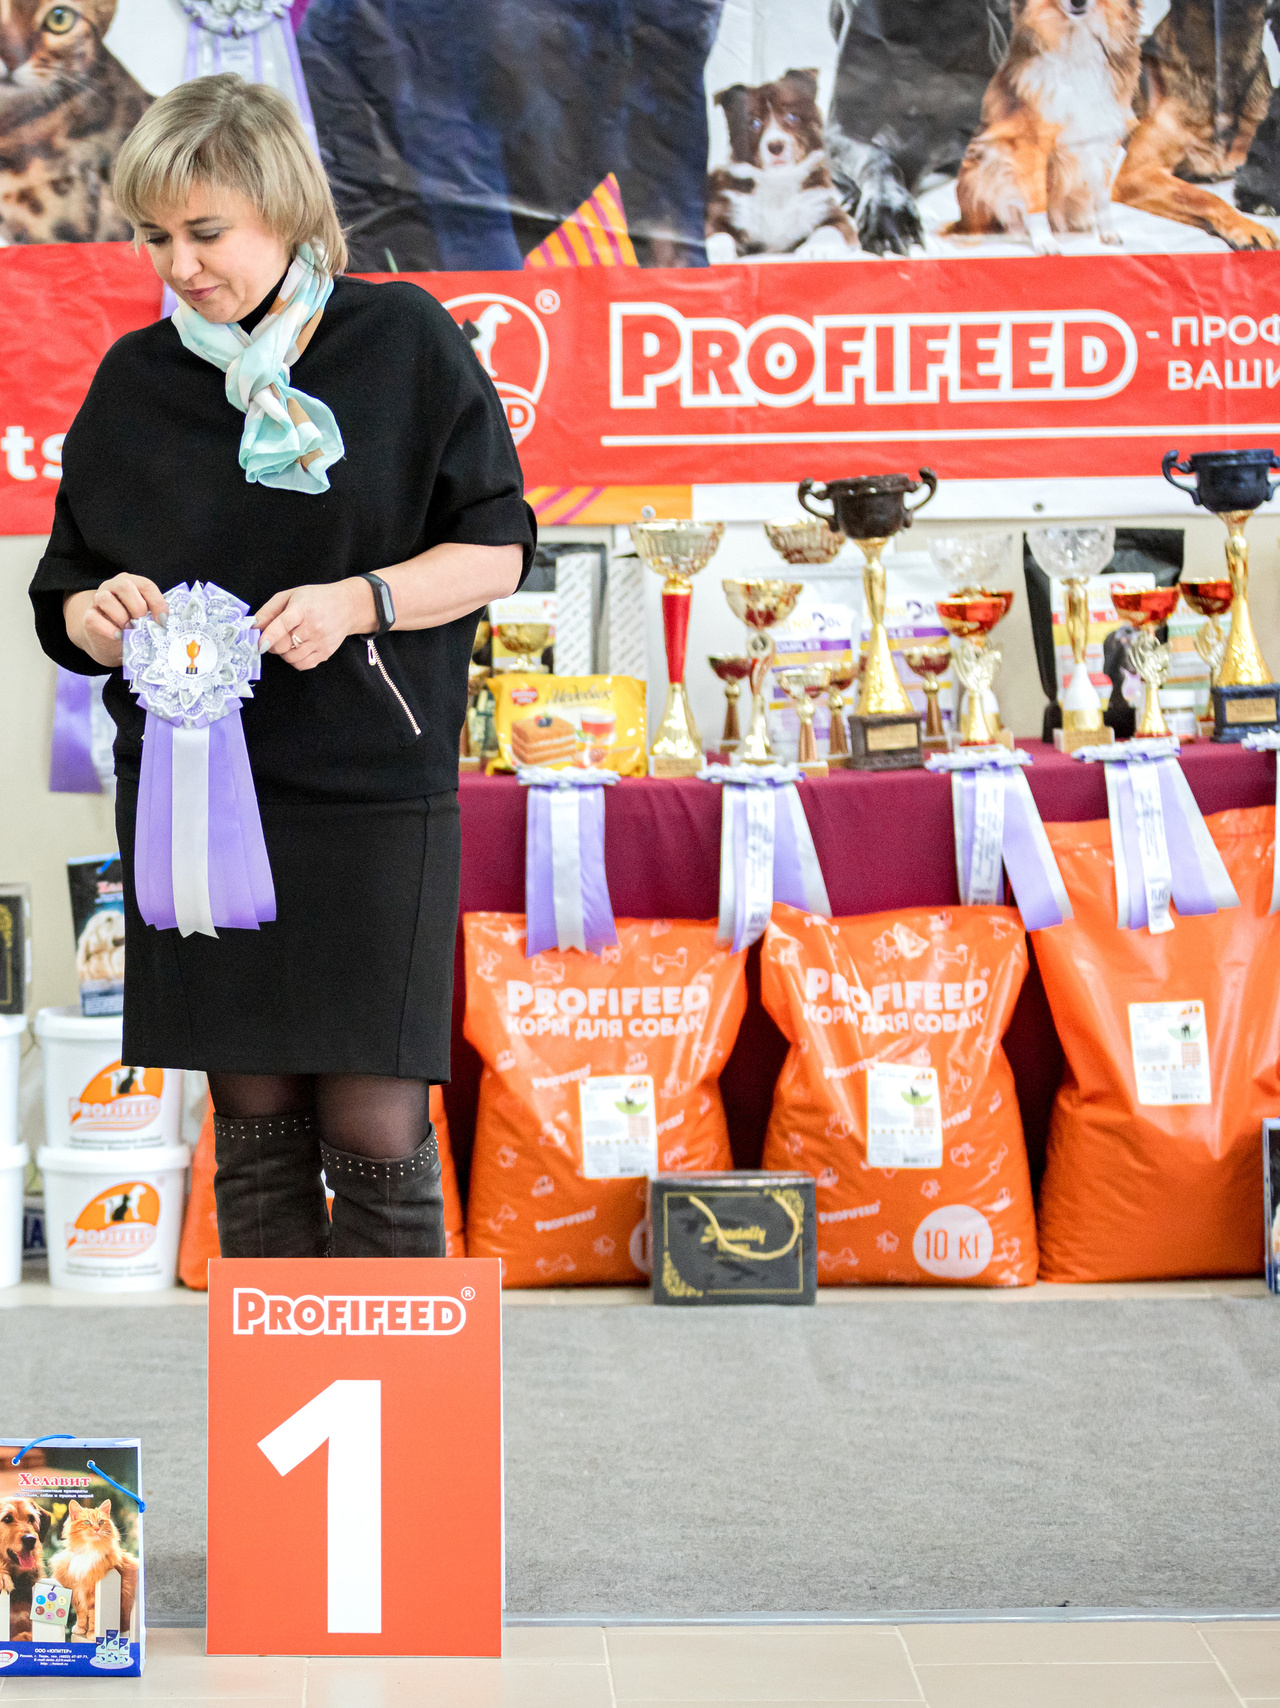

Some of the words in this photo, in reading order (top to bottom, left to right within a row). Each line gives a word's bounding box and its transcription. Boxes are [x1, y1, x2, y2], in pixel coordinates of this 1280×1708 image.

[610, 302, 1138, 408] PROFIFEED
[507, 979, 710, 1017] PROFIFEED
[924, 1229, 948, 1261] 10
[233, 1287, 466, 1336] PROFIFEED
[19, 1472, 91, 1487] Хелавит
[257, 1380, 382, 1634] 1
